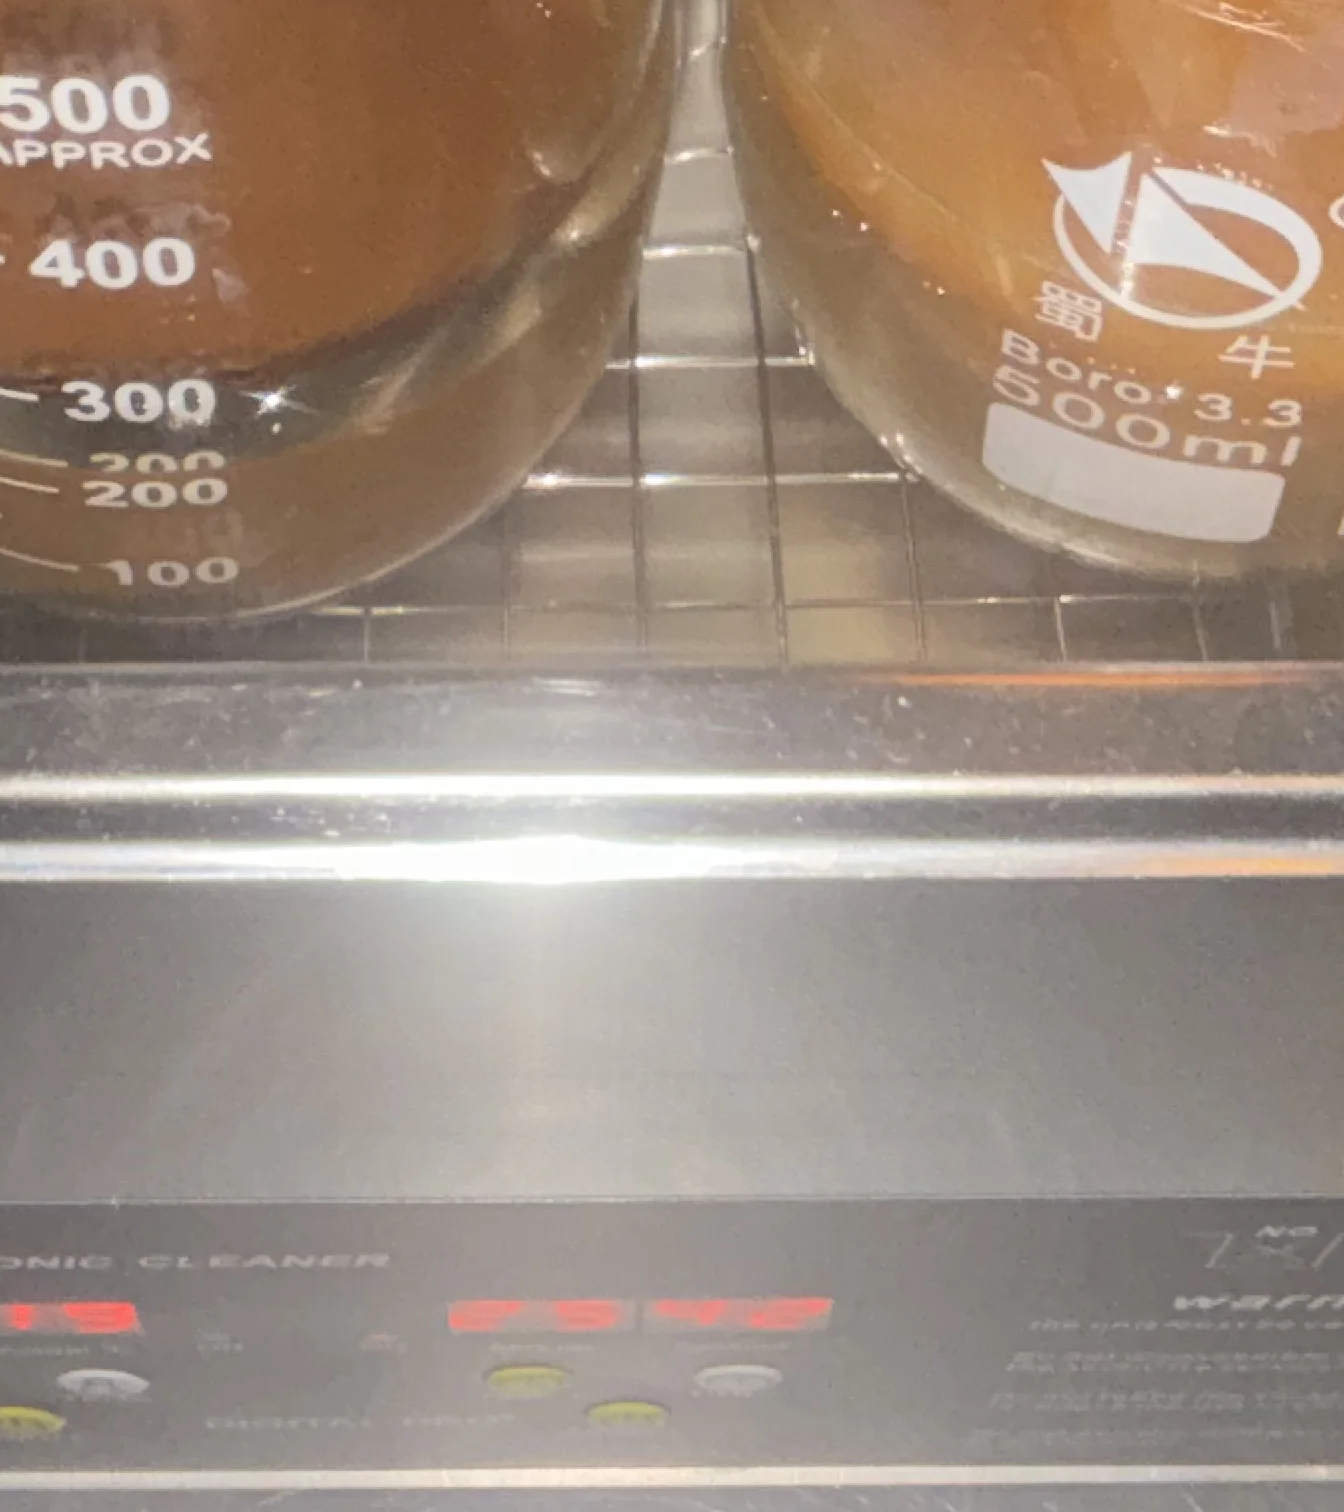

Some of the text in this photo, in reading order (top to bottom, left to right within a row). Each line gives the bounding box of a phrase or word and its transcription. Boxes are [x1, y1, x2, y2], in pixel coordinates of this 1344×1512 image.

[28, 237, 196, 289] 400
[60, 378, 217, 425] 300
[1000, 328, 1303, 430] Boro 3.3
[992, 365, 1303, 467] 500ml
[81, 478, 229, 509] 200
[106, 556, 240, 587] 100
[136, 1251, 392, 1270] CLEANER
